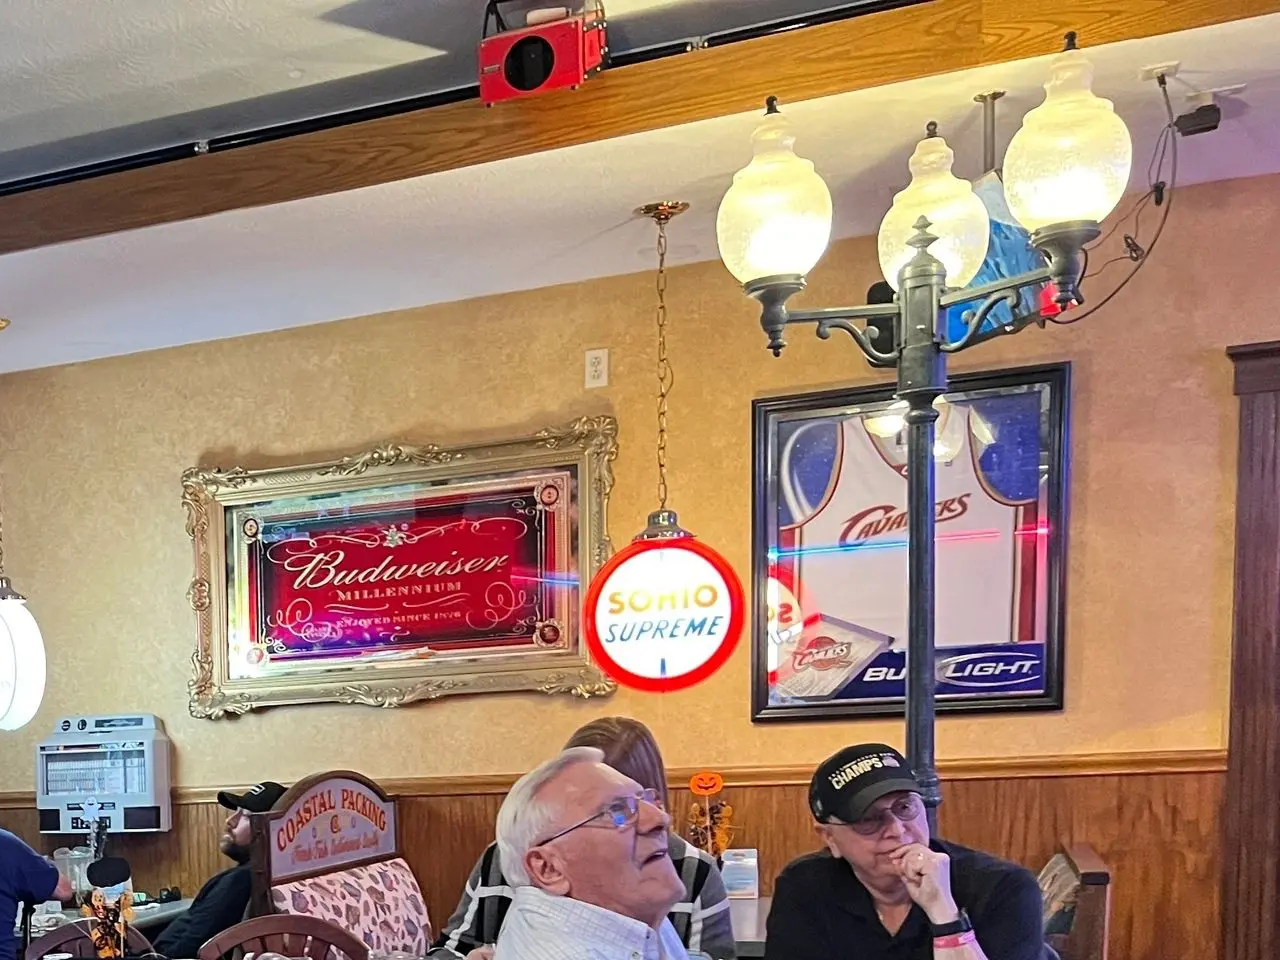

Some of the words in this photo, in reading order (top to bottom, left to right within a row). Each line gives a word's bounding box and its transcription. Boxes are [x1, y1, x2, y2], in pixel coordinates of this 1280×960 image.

[839, 492, 972, 549] CAVARS
[284, 550, 509, 590] Budweiser
[337, 581, 462, 602] MILLENNIUM
[608, 584, 718, 615] SOHIO
[605, 615, 724, 643] SUPREME
[862, 667, 907, 682] BU
[945, 660, 1041, 678] LIGHT
[831, 757, 883, 790] CHAMPS
[277, 789, 336, 852] COASTAL
[340, 788, 387, 832] PACKING
